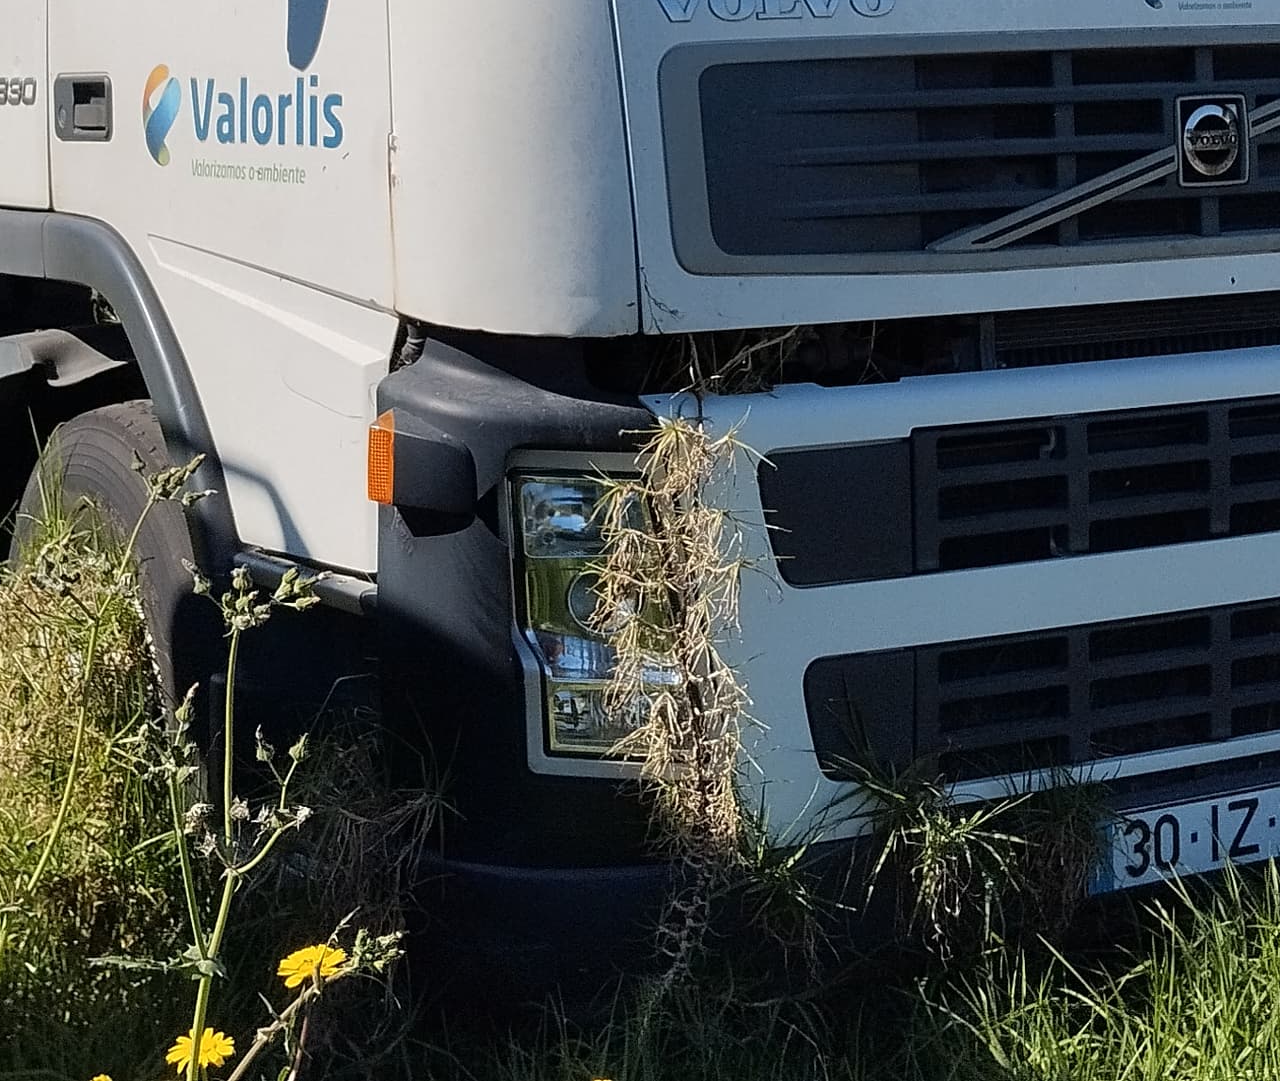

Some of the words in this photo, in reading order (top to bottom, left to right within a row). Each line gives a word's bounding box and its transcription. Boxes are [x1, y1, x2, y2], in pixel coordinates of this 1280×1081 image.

[190, 75, 344, 149] Valorlis
[1186, 132, 1237, 147] VOLVO
[191, 158, 246, 181] Valorizamos
[248, 167, 255, 182] o
[256, 162, 306, 184] ambiente
